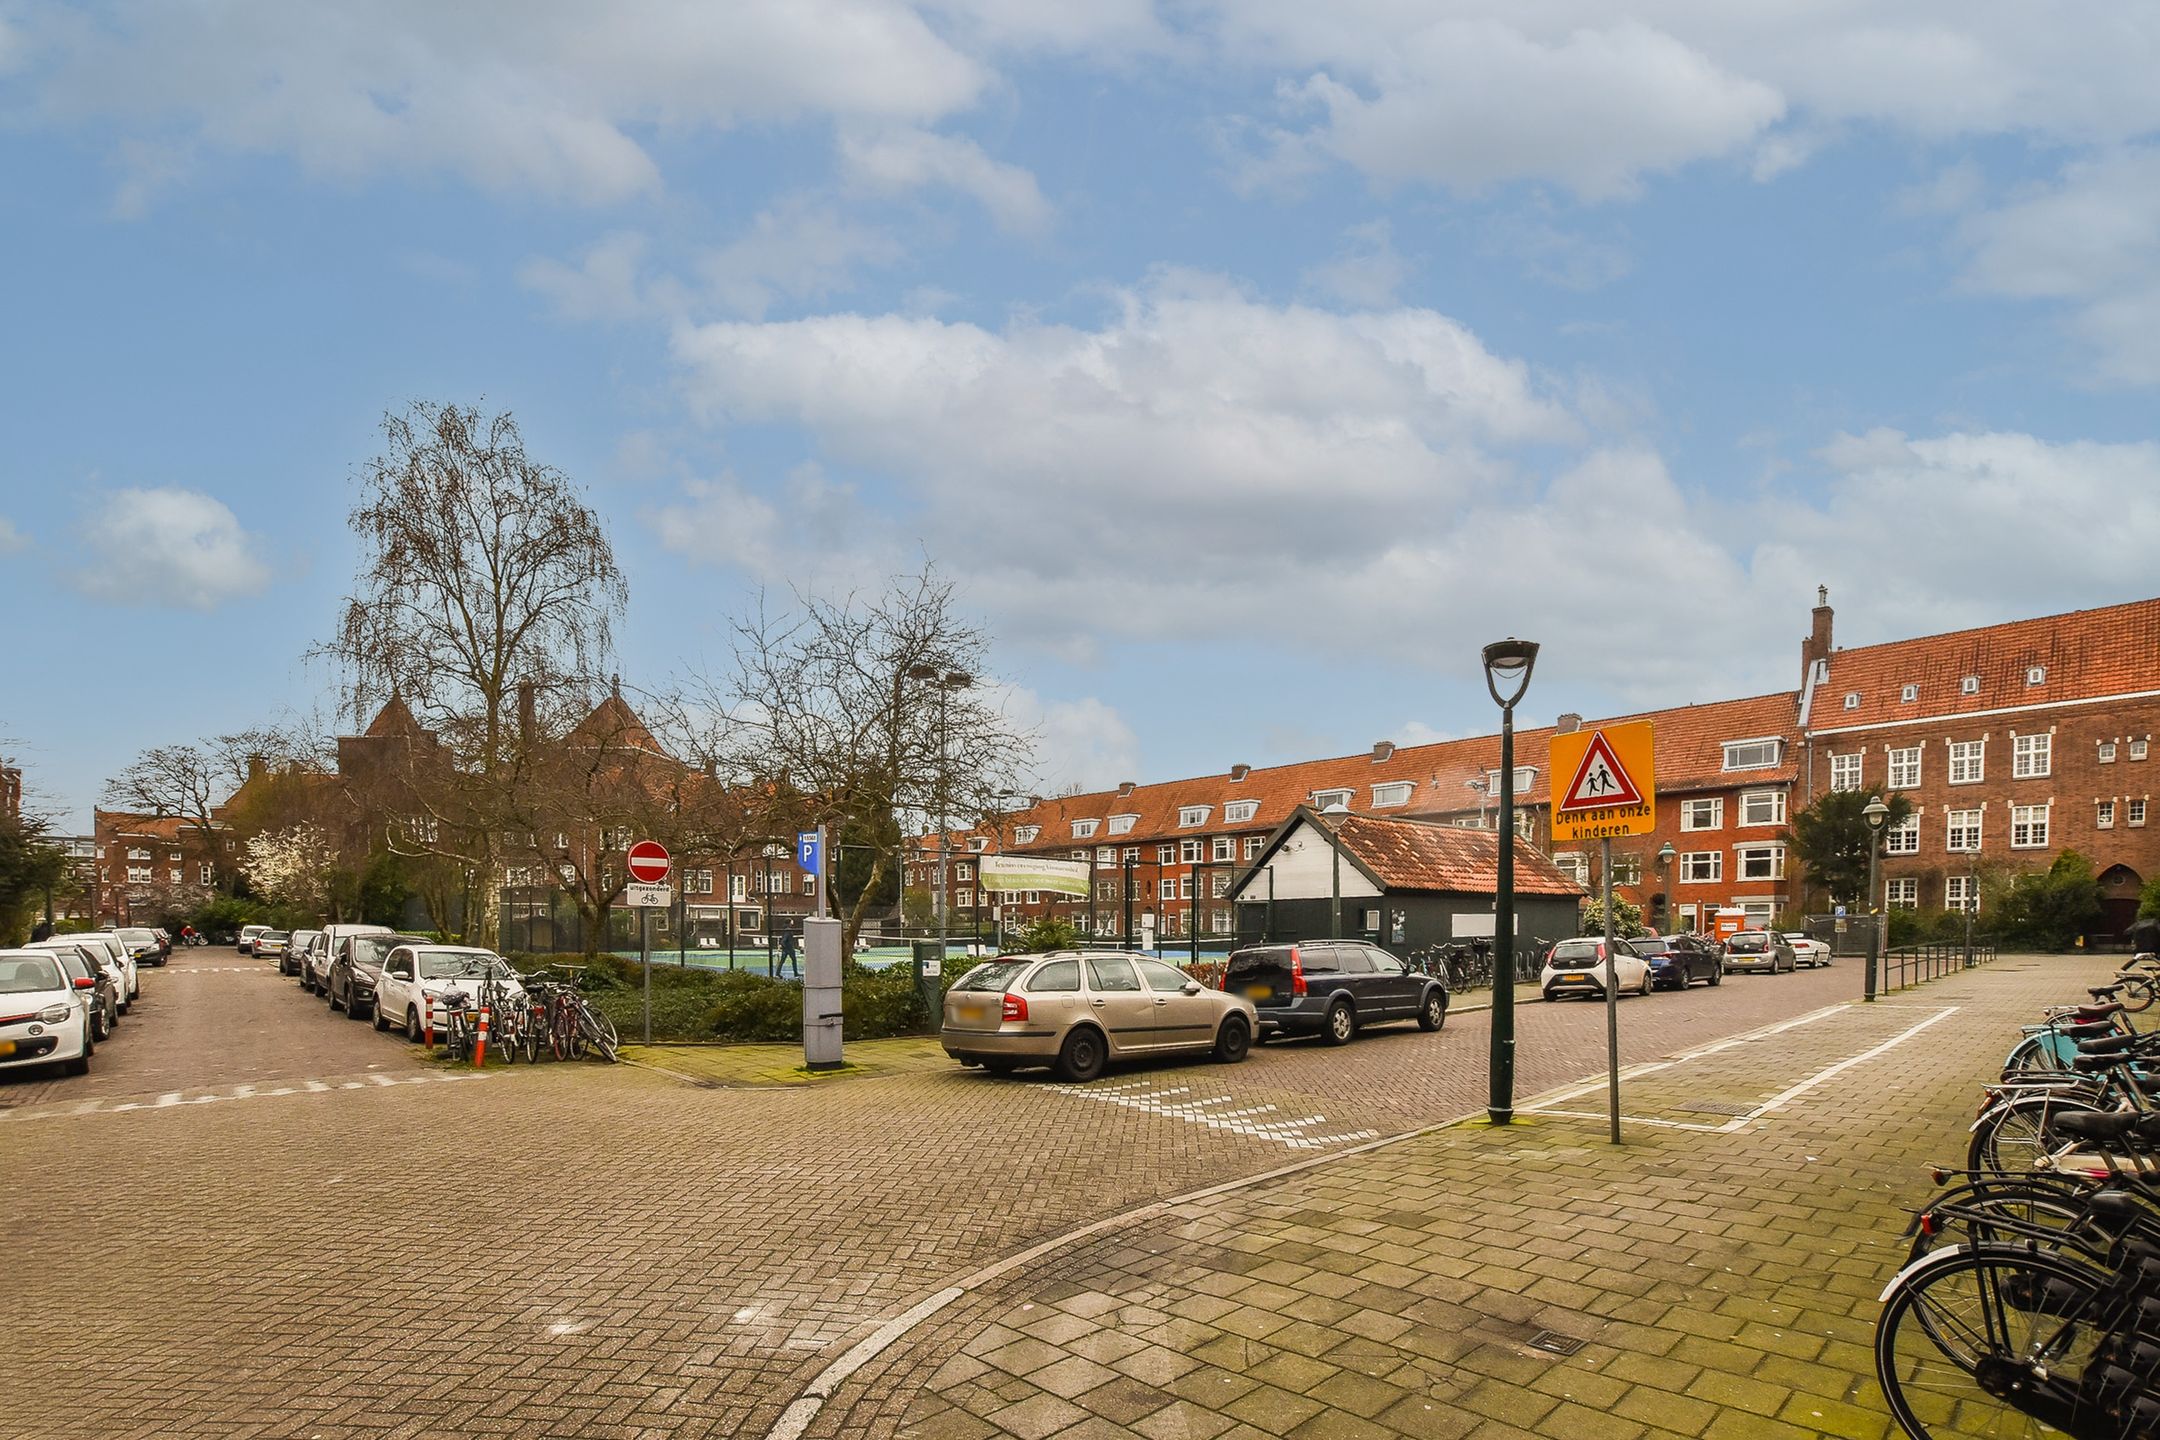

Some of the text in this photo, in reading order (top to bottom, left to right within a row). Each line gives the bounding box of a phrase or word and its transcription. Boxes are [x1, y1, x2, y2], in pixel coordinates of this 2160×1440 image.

[1556, 805, 1651, 825] Denk aan onze
[1572, 825, 1629, 838] kinderen
[803, 844, 813, 862] P
